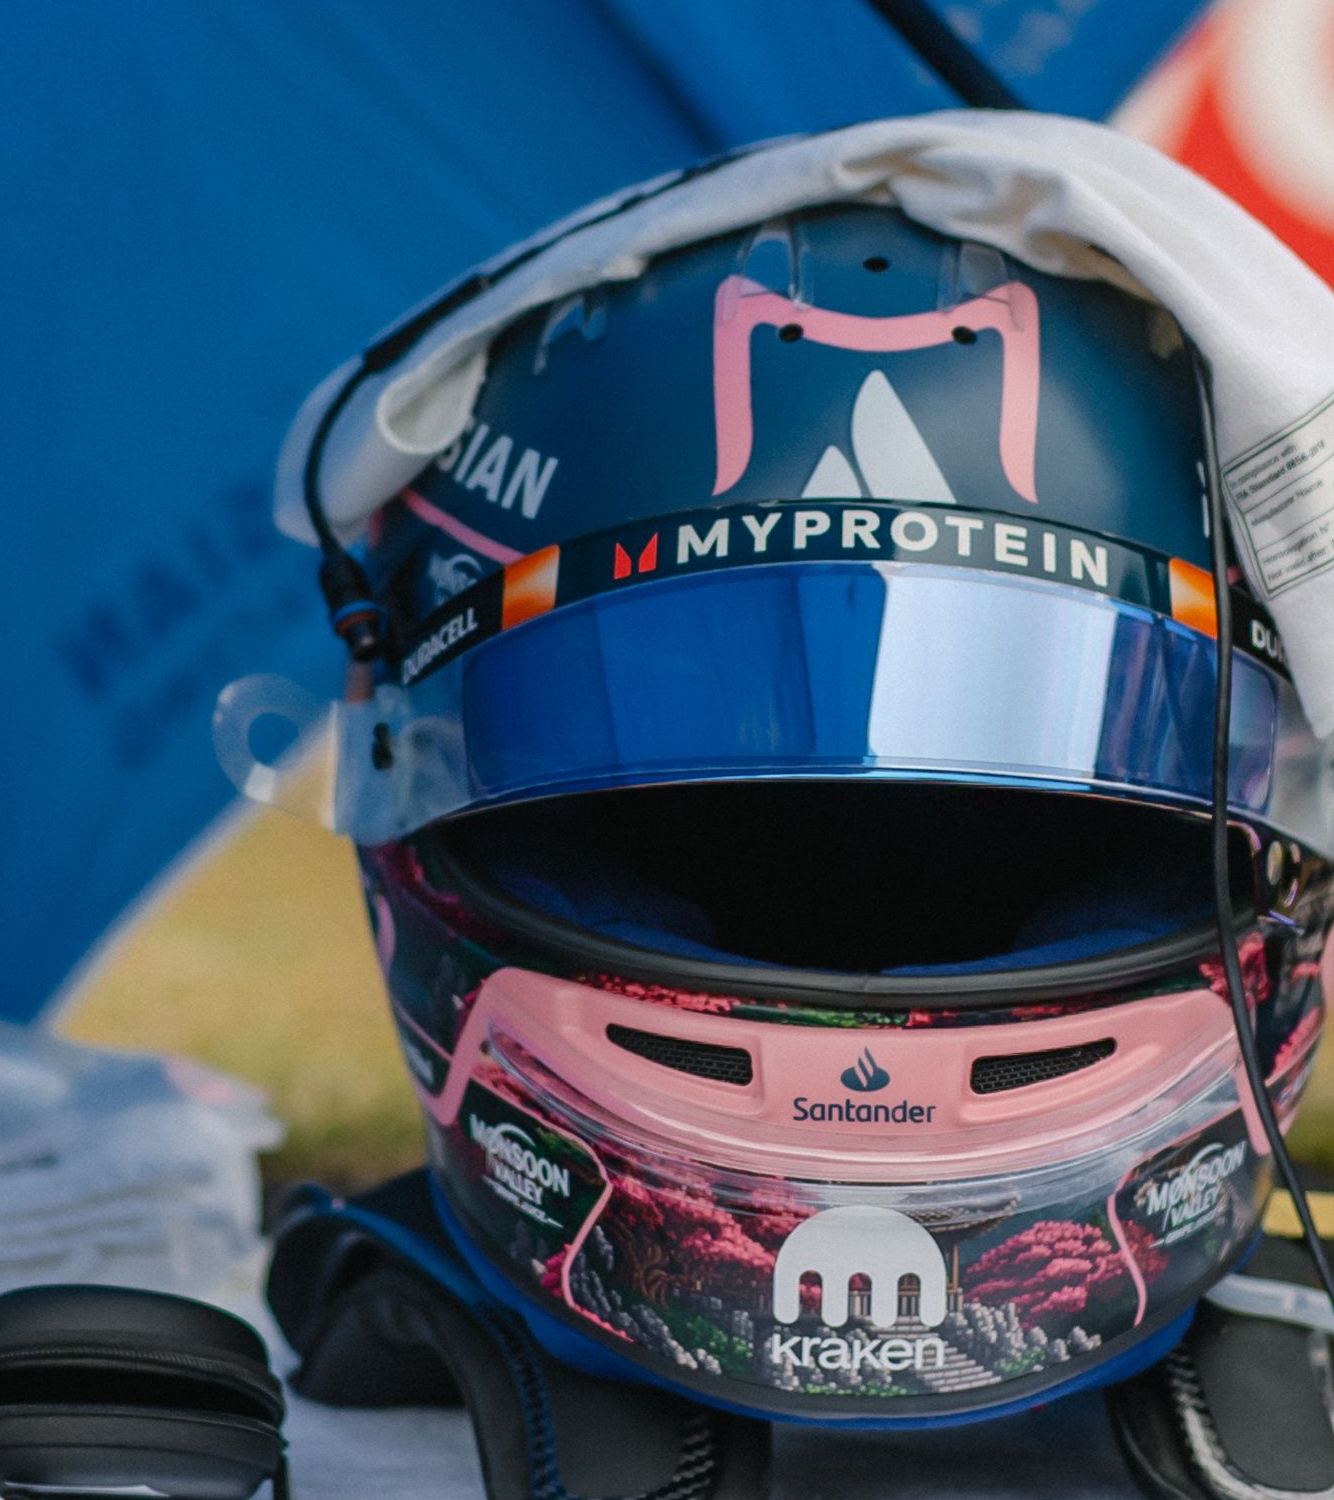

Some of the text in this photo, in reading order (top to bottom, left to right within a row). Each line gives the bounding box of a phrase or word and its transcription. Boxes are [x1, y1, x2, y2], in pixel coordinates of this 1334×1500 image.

[677, 509, 1109, 587] MYPROTEIN
[402, 607, 479, 687] DURACELL
[793, 1096, 937, 1123] Santander
[1146, 1141, 1247, 1216] MONSOON
[772, 1333, 945, 1372] kraken
